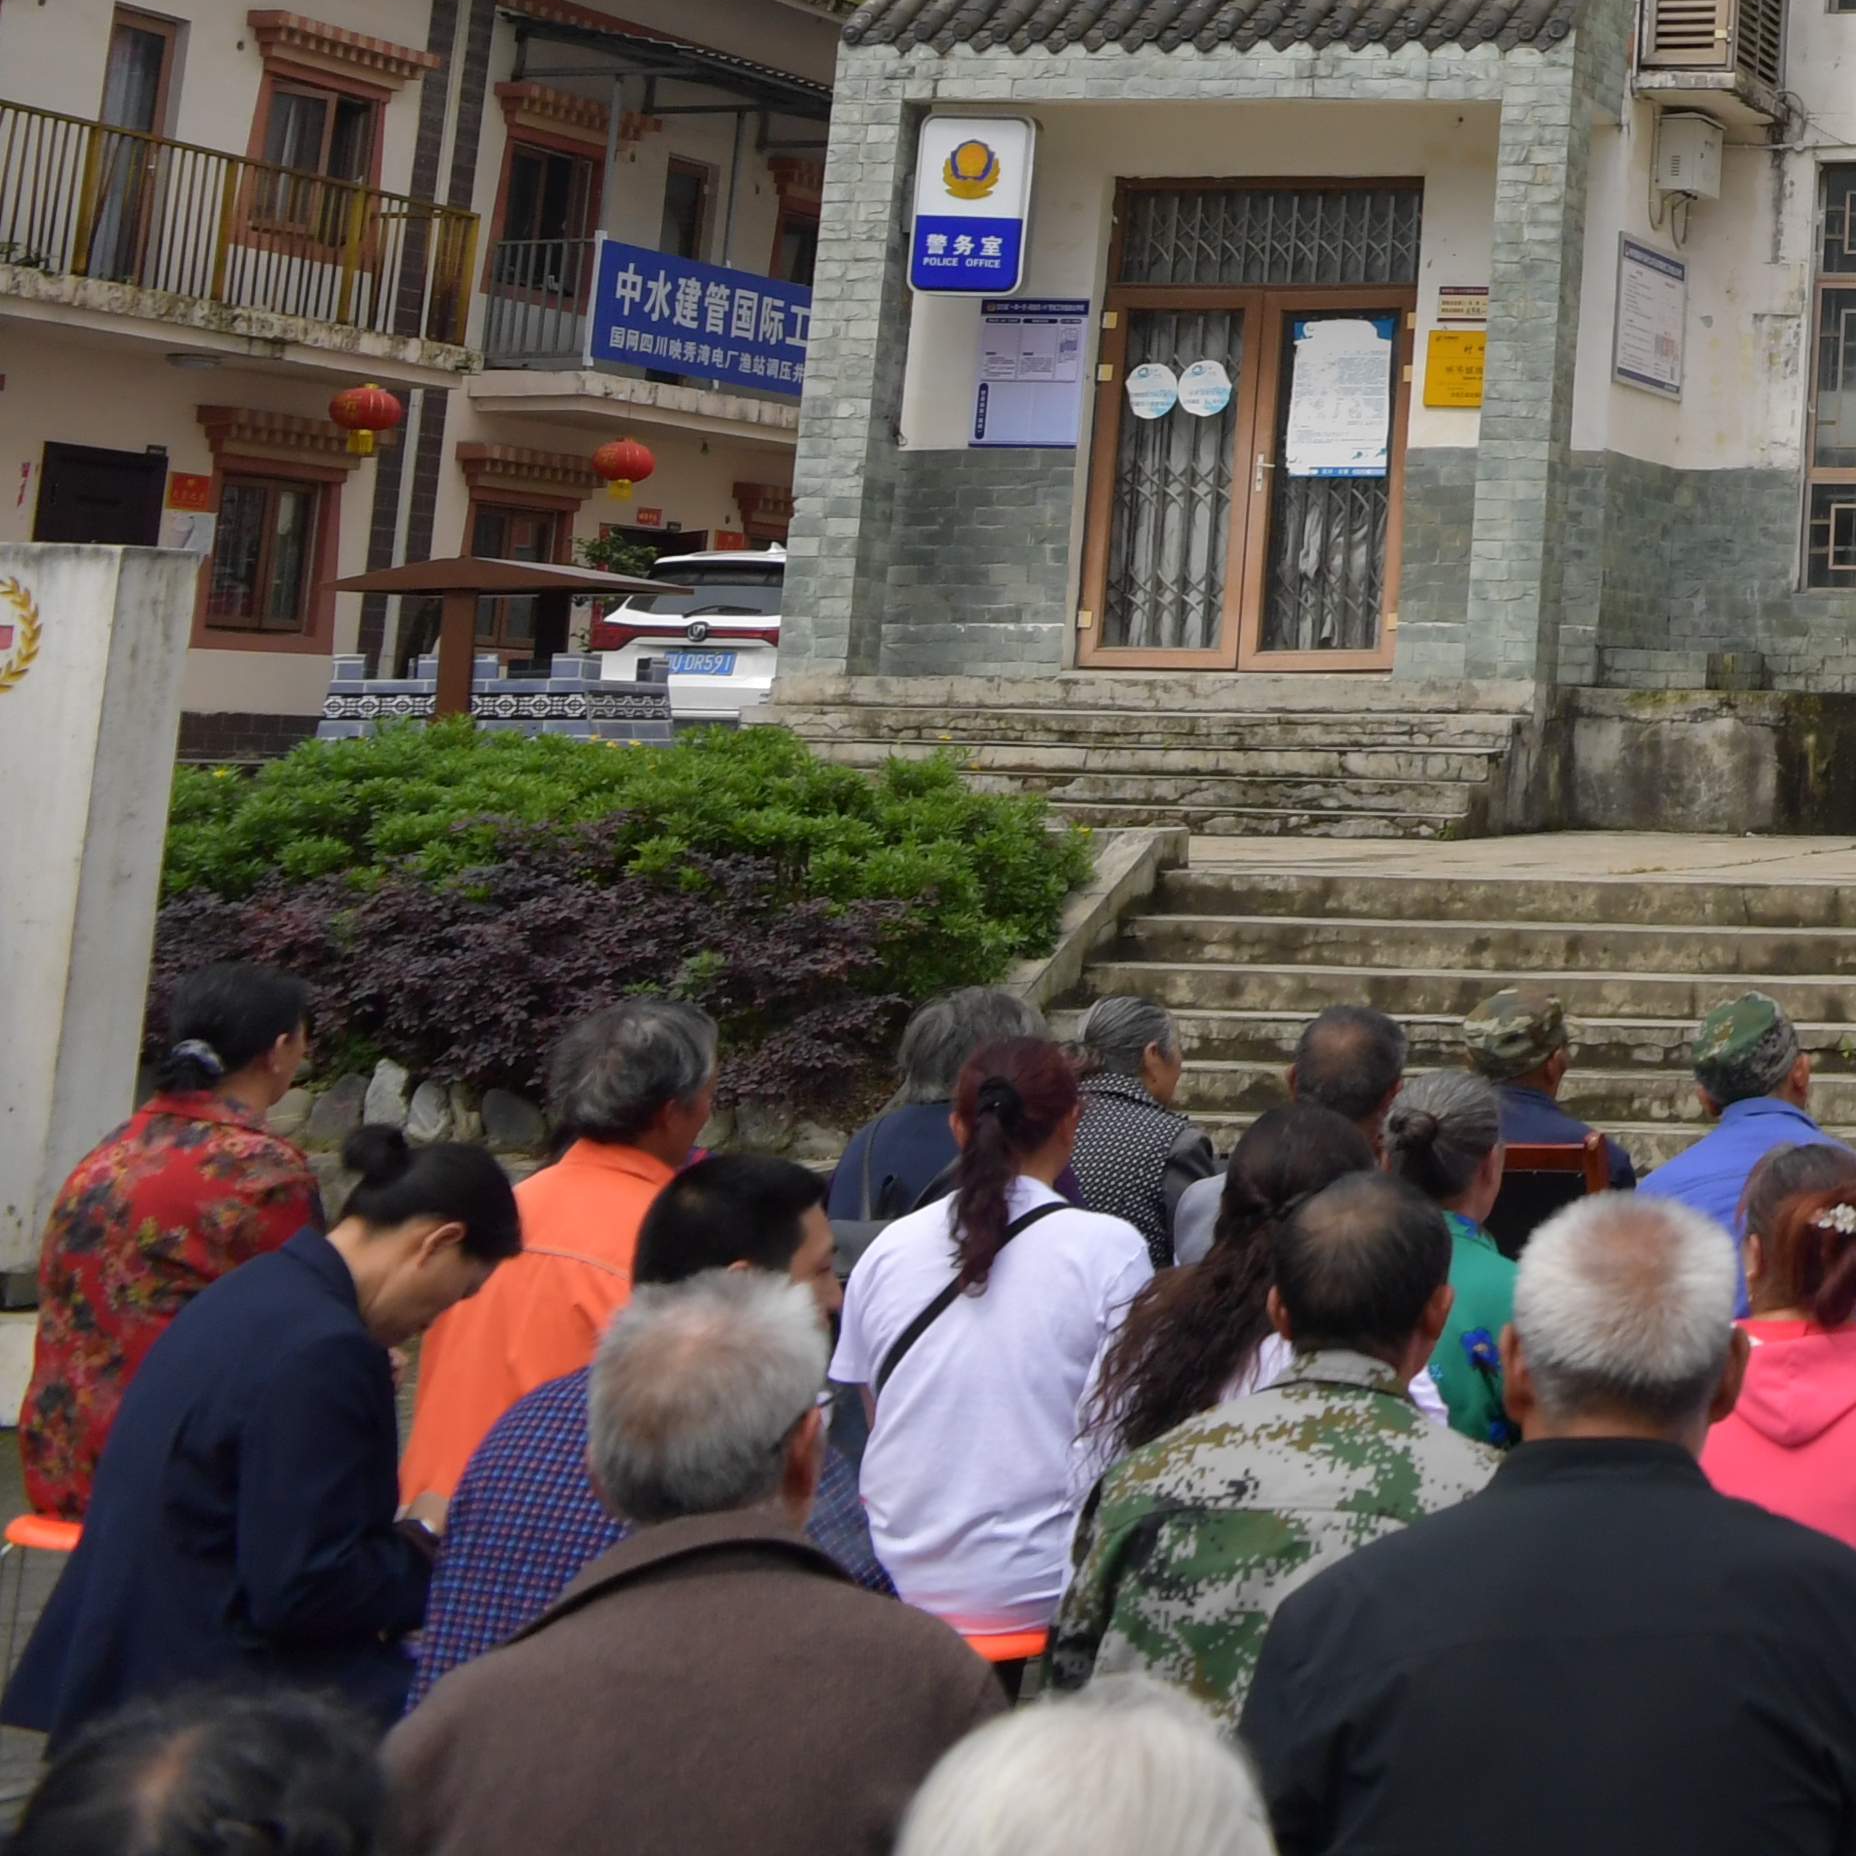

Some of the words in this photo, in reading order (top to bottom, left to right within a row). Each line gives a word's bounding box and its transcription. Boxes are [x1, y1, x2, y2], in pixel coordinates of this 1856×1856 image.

[926, 233, 1003, 257] 警务室
[923, 257, 959, 267] POLICE
[965, 258, 1001, 269] OFFICE
[615, 262, 813, 349] 中水建管国际工
